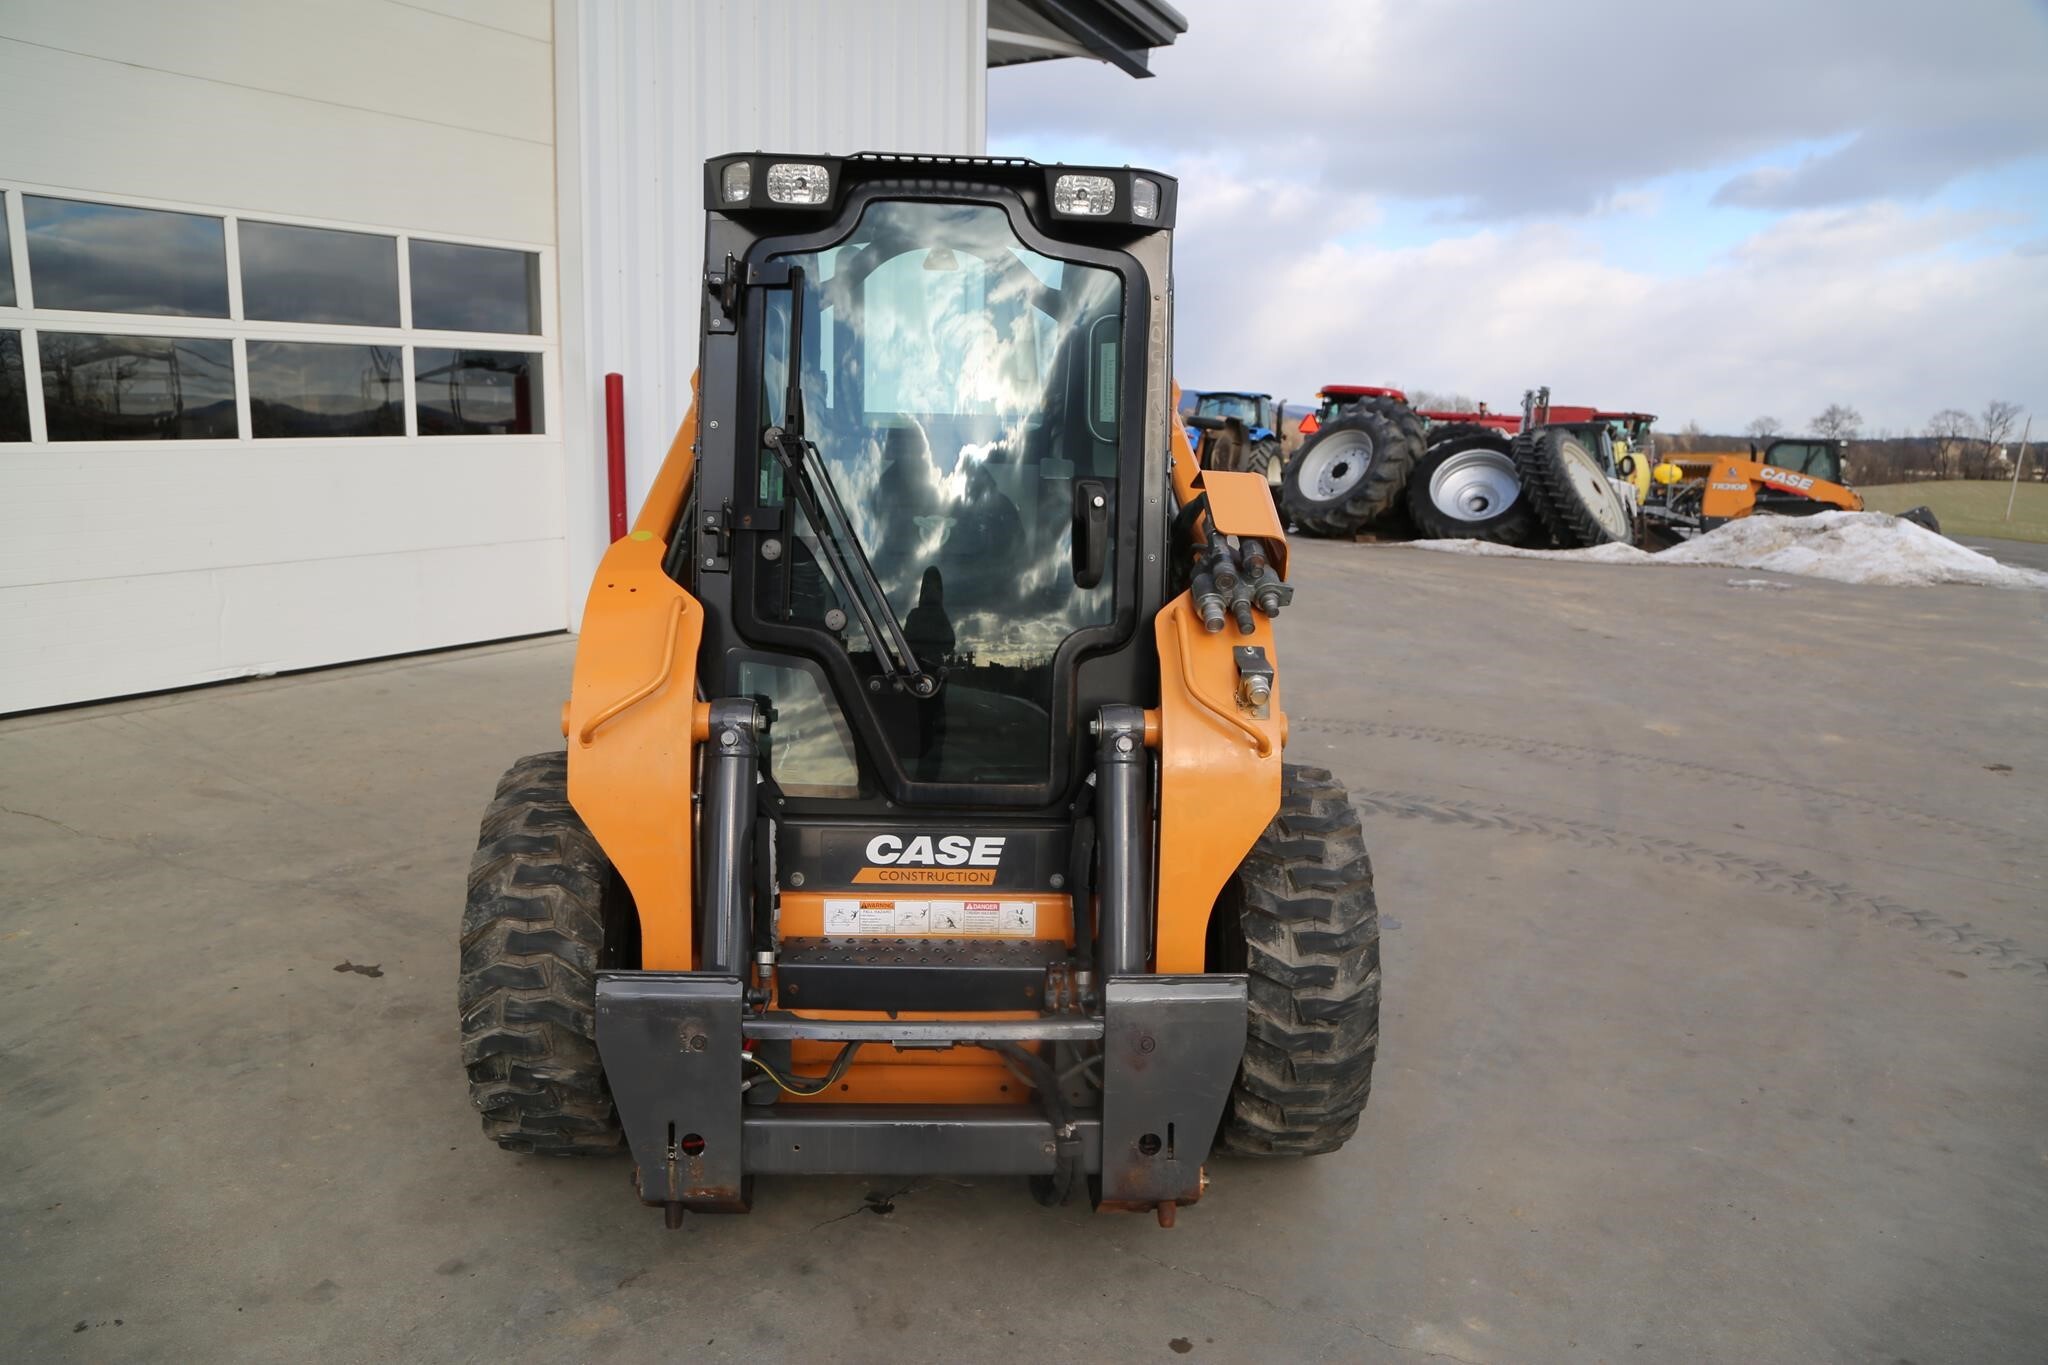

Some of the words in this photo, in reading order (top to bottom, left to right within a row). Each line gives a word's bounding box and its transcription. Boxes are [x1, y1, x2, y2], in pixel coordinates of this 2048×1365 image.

[1760, 467, 1814, 490] CASE
[865, 834, 1006, 866] CASE
[878, 870, 991, 883] CONSTRUCTION
